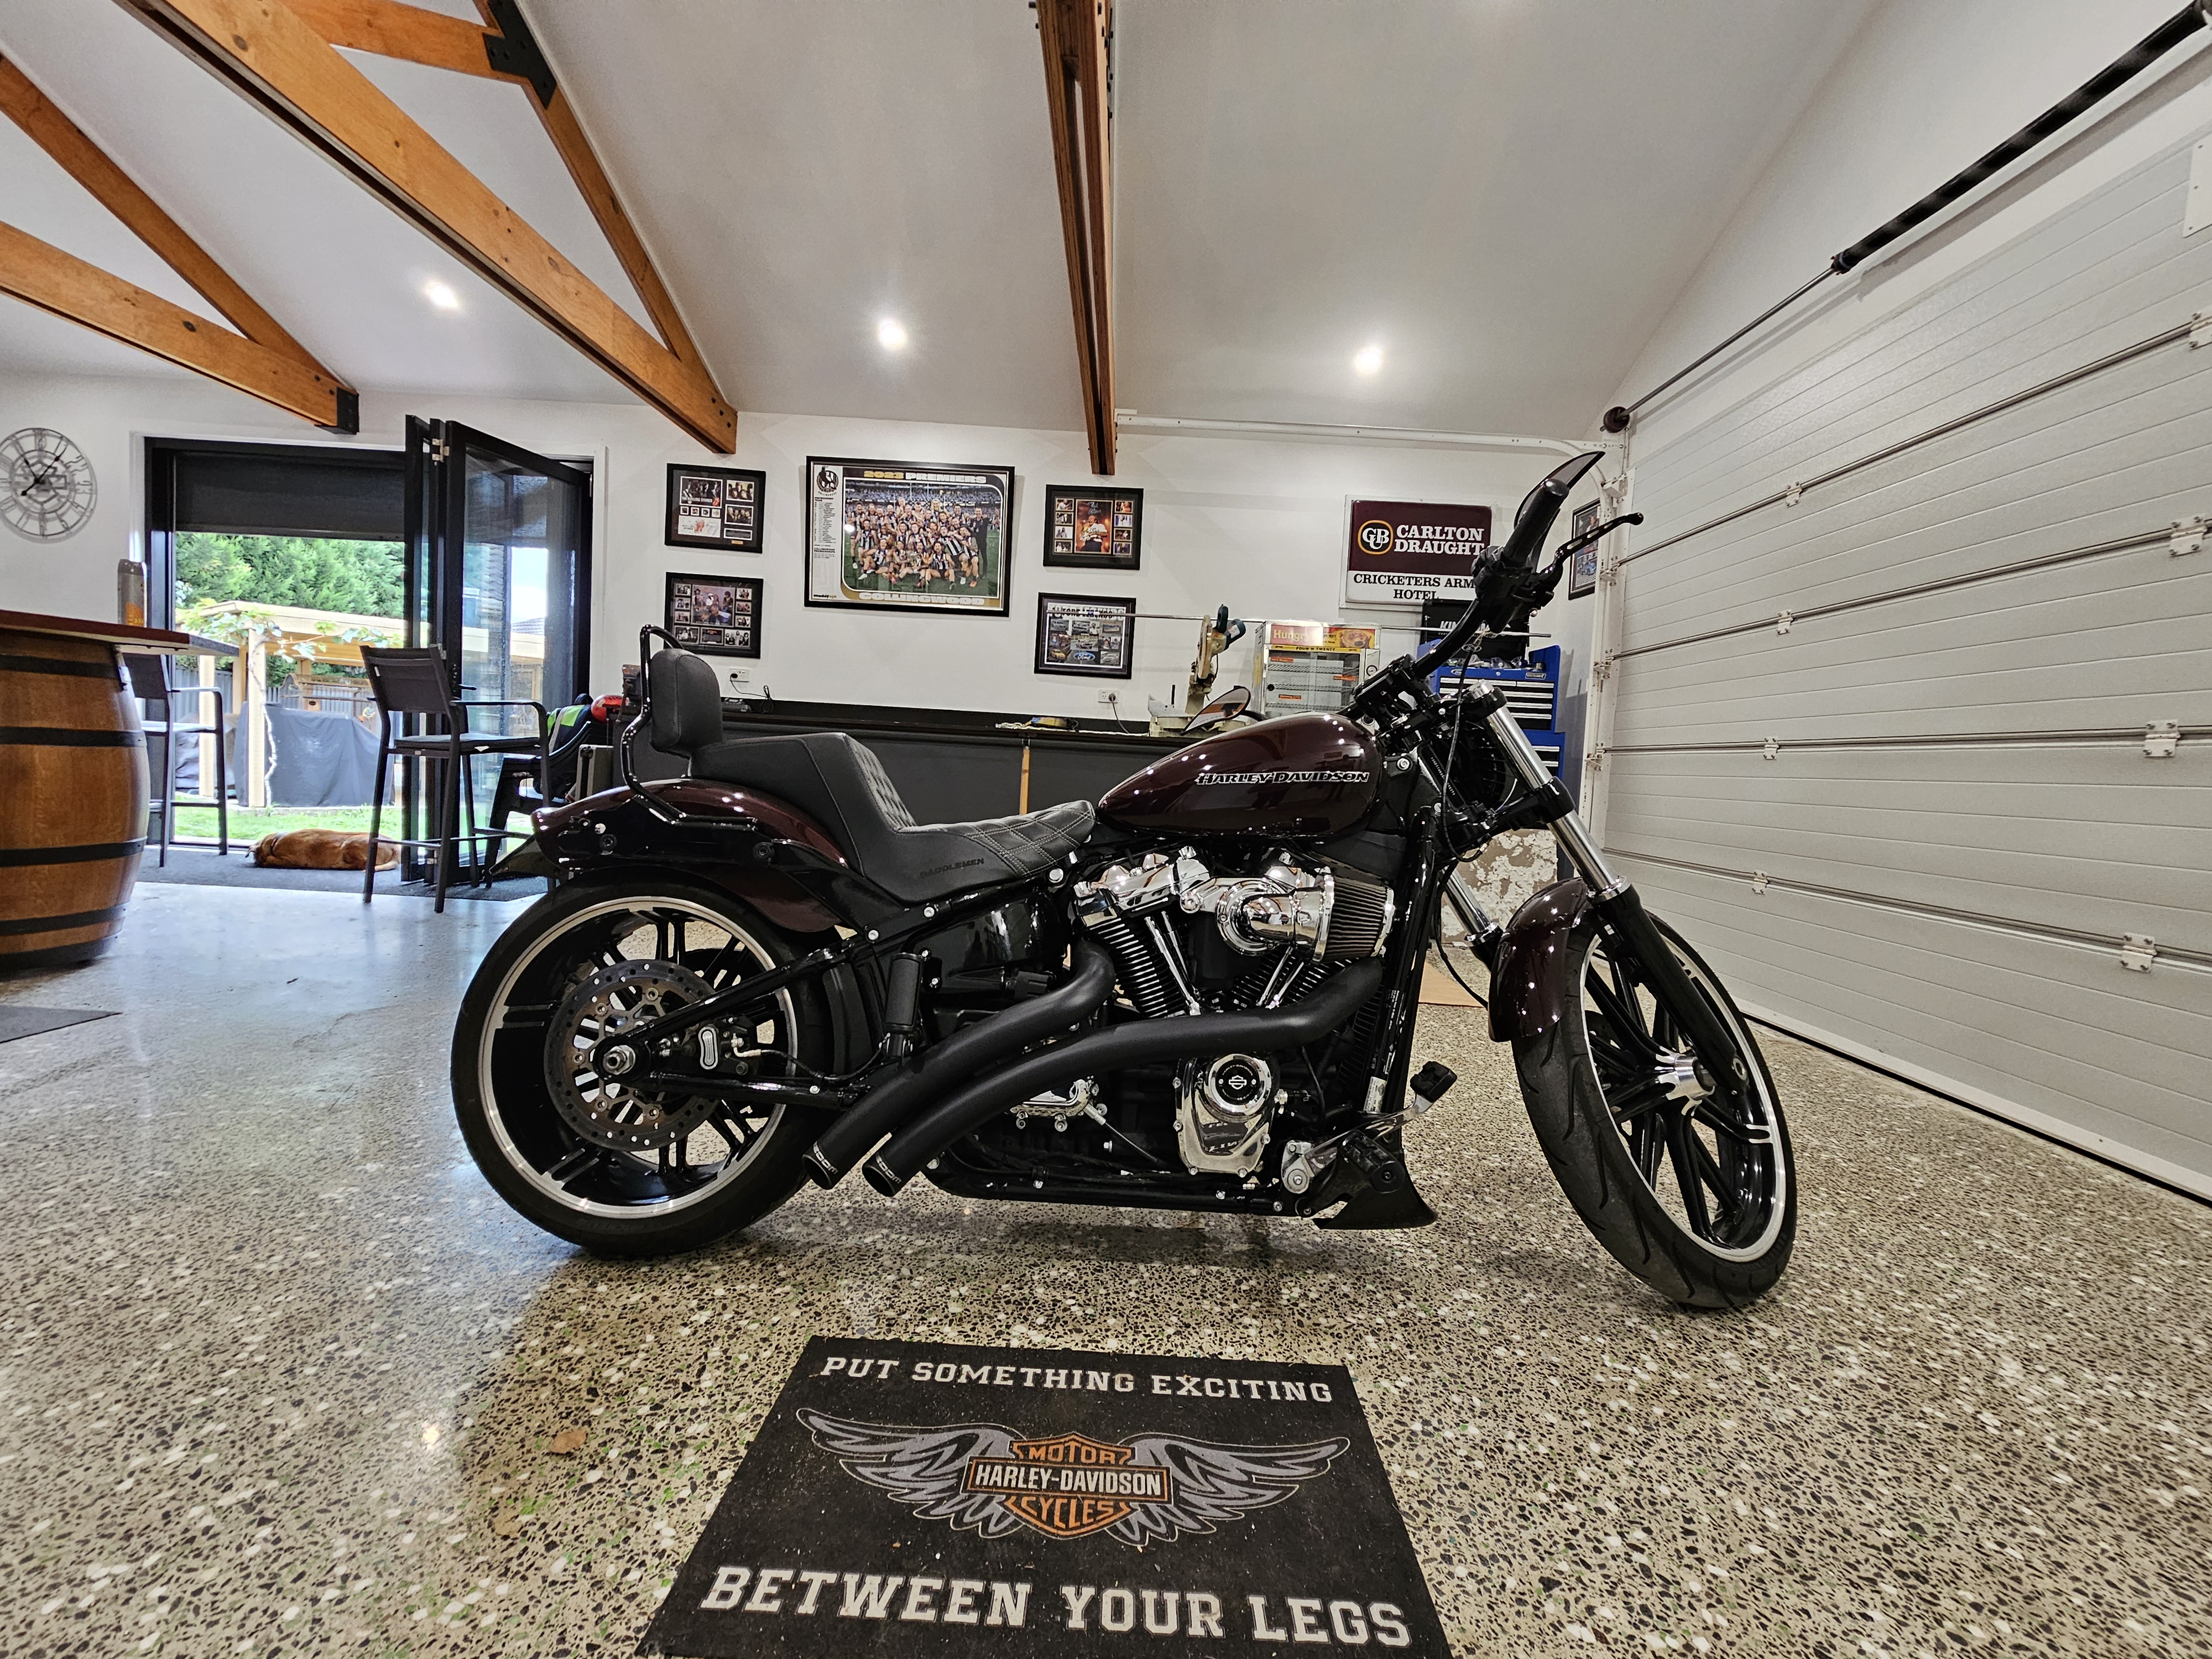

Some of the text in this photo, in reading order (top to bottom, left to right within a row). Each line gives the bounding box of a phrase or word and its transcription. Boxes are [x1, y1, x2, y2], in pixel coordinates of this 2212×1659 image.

[864, 471, 987, 483] 2023 PREMIERS
[1396, 525, 1484, 541] CARLTON
[1394, 539, 1485, 555] DRAUGHT
[1354, 573, 1476, 588] CRICKETERS ARM
[859, 592, 985, 606] COLLINGWOOD
[1393, 589, 1439, 600] HOTEL
[820, 1357, 1332, 1402] PUT SOMETHING EXCITING
[1028, 1440, 1117, 1464] MOTOR
[975, 1464, 1161, 1496] HARLEY-DAVIDSON
[1020, 1496, 1114, 1529] CYCLES
[699, 1566, 1412, 1647] BETWEEN YOUR LEGS
